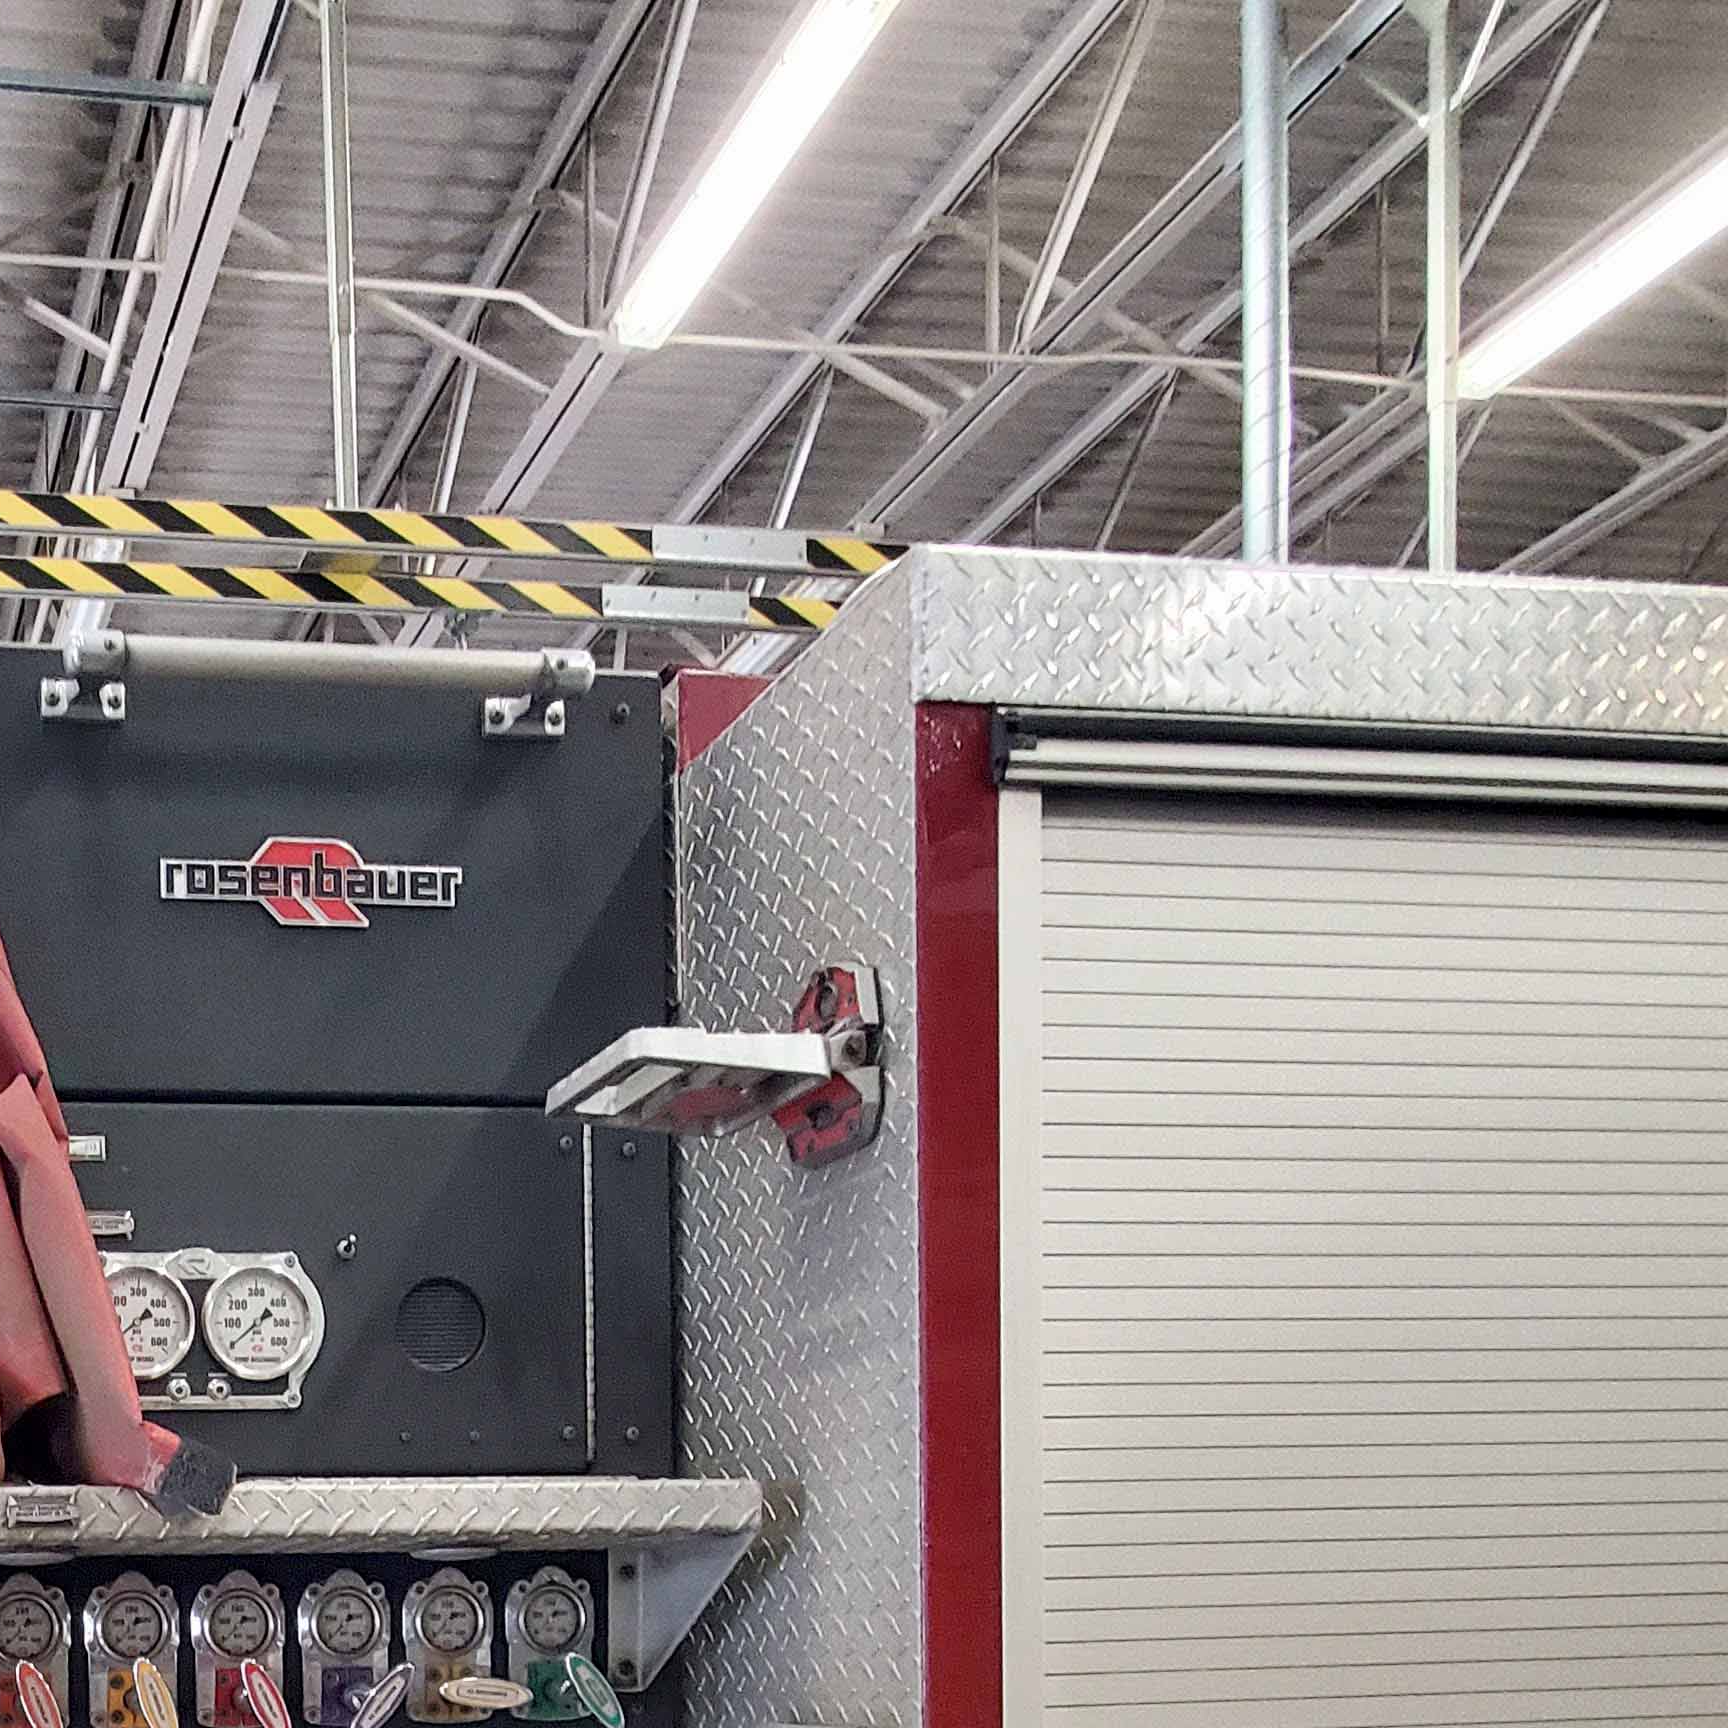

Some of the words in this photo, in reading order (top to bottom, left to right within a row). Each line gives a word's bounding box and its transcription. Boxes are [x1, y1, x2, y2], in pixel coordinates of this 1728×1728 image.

[164, 850, 459, 902] rosenbauer
[228, 1300, 248, 1311] 200
[224, 1318, 242, 1329] 100
